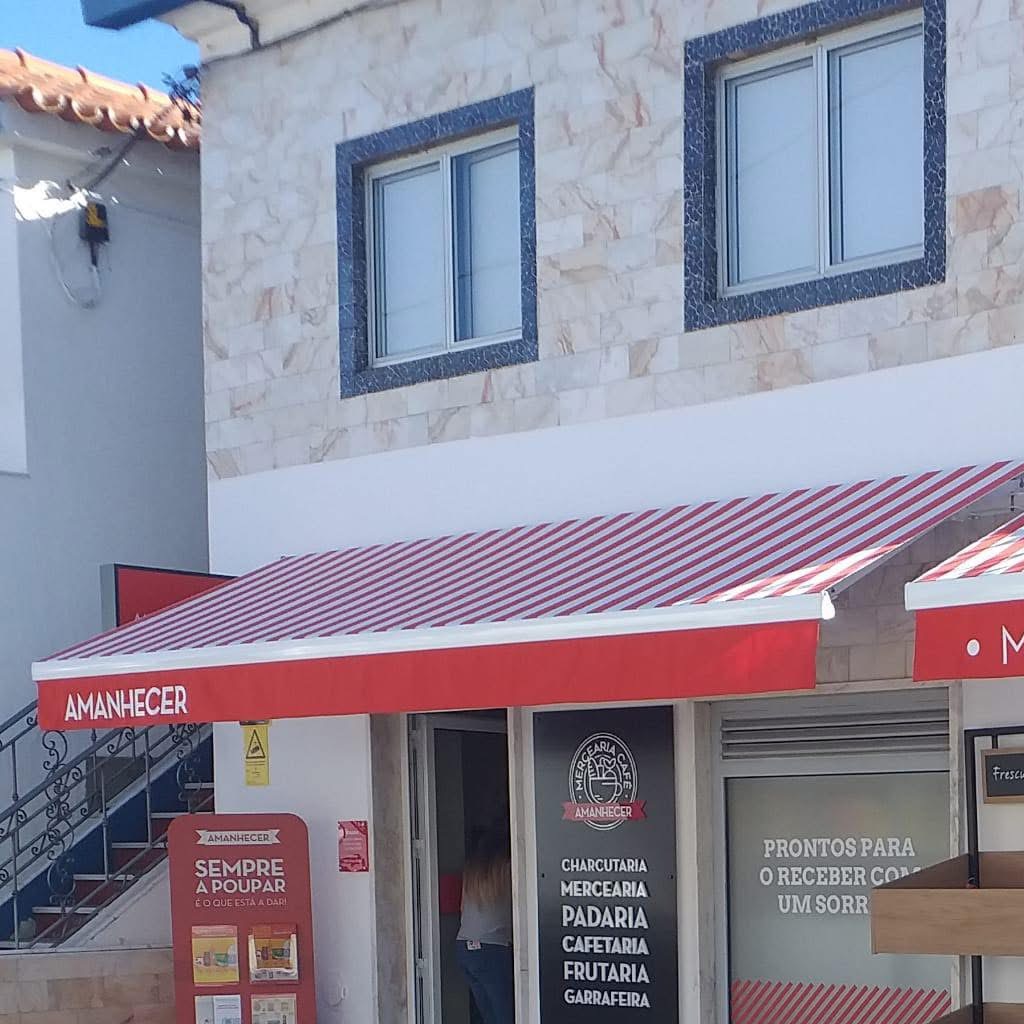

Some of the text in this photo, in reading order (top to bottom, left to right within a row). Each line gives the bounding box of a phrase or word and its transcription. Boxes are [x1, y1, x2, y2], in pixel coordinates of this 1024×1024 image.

[64, 685, 188, 722] AMANHECER
[574, 740, 617, 792] MERCEARIA
[575, 805, 632, 818] AMANHECER
[207, 833, 270, 842] AMANHECER
[763, 837, 916, 858] PRONTOS PARA
[194, 858, 285, 878] SEMPRE
[561, 858, 648, 873] CHARCUTARIA
[759, 867, 774, 886] O
[777, 866, 867, 886] RECEBER
[195, 879, 286, 894] A POUPAR
[560, 880, 649, 898] MERCEARIA
[202, 899, 212, 907] O
[212, 899, 233, 907] QUE
[777, 894, 869, 914] UM SORR
[562, 905, 649, 929] PADARIA
[562, 935, 650, 955] CAFETARIA
[564, 961, 650, 984] FRUTARIA
[564, 989, 651, 1008] GARRAFEIRA
